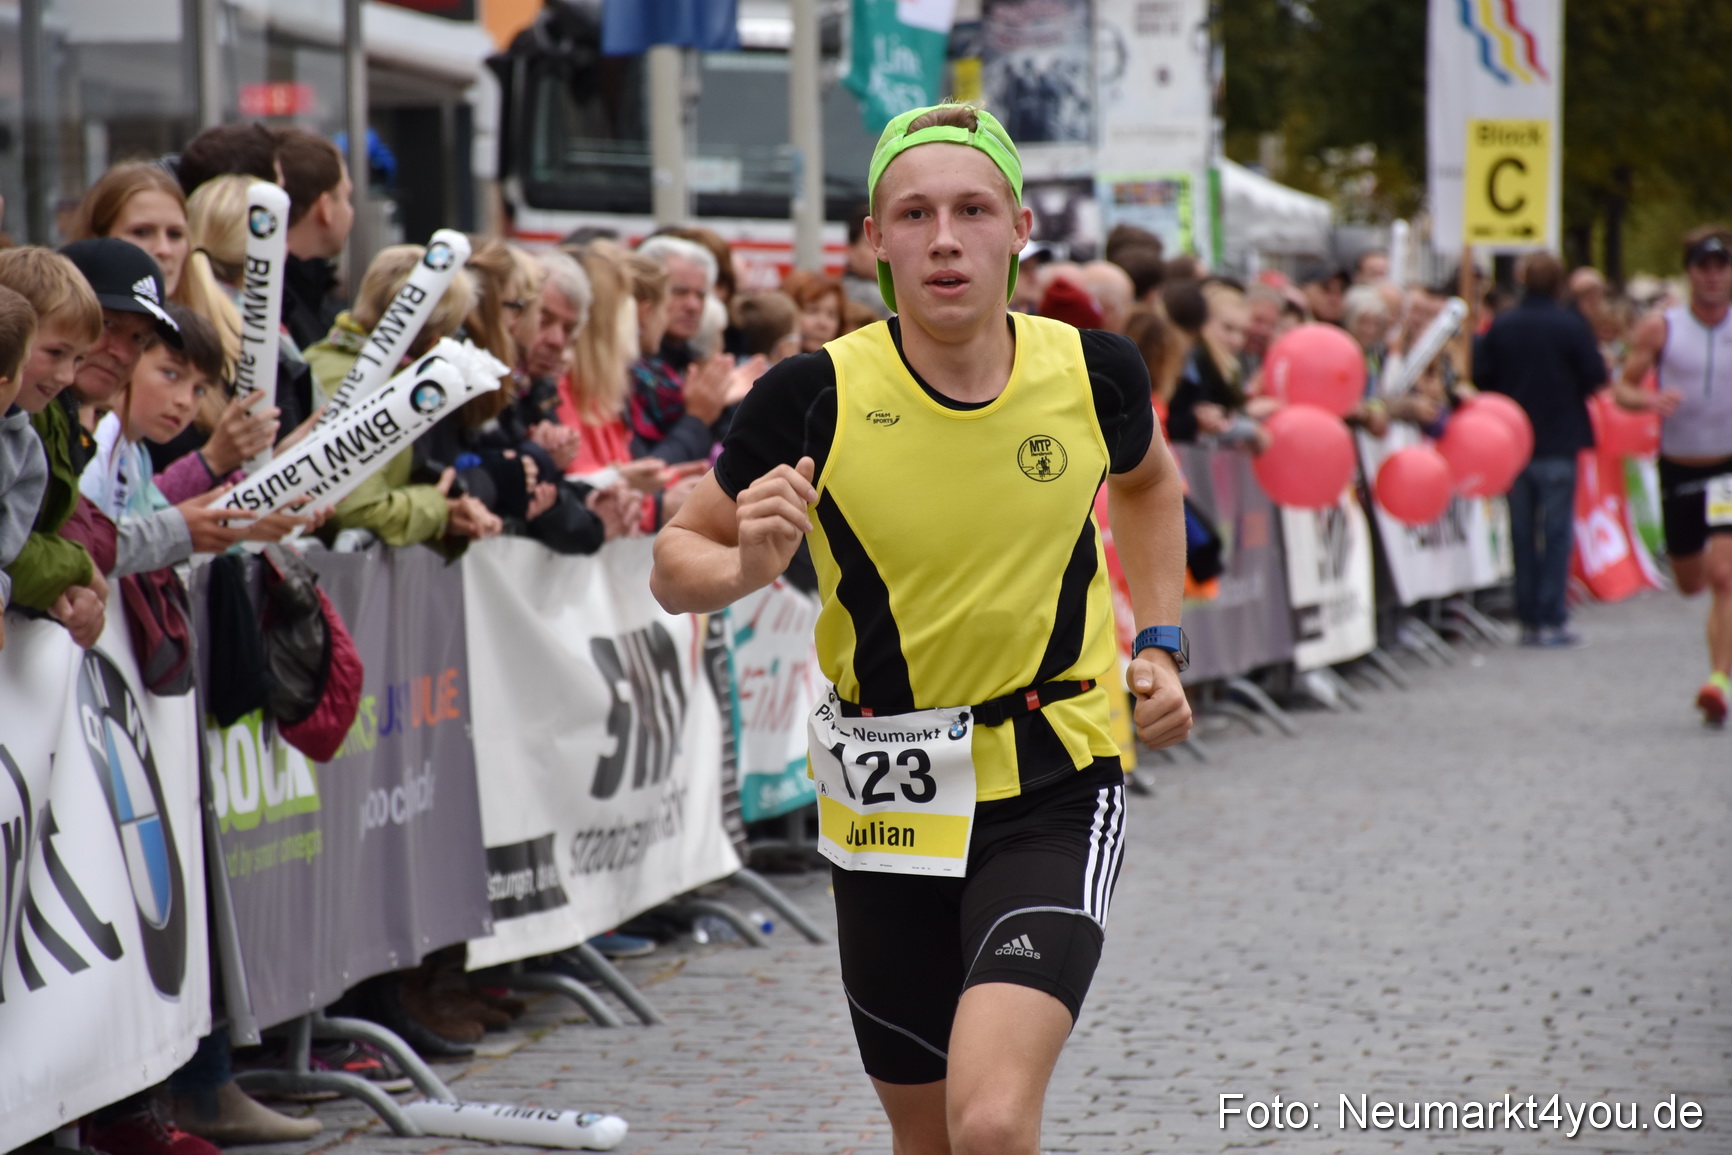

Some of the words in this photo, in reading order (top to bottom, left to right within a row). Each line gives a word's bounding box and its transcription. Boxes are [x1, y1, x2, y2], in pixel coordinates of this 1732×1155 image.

[1486, 156, 1527, 217] C
[243, 255, 270, 332] BMW
[371, 283, 427, 356] BMW
[323, 407, 401, 472] BMW
[1029, 439, 1052, 453] MTP
[852, 726, 942, 744] Neumarkt
[820, 783, 828, 795] A
[829, 742, 938, 806] 123
[846, 821, 915, 847] Julian
[995, 946, 1041, 960] adidas
